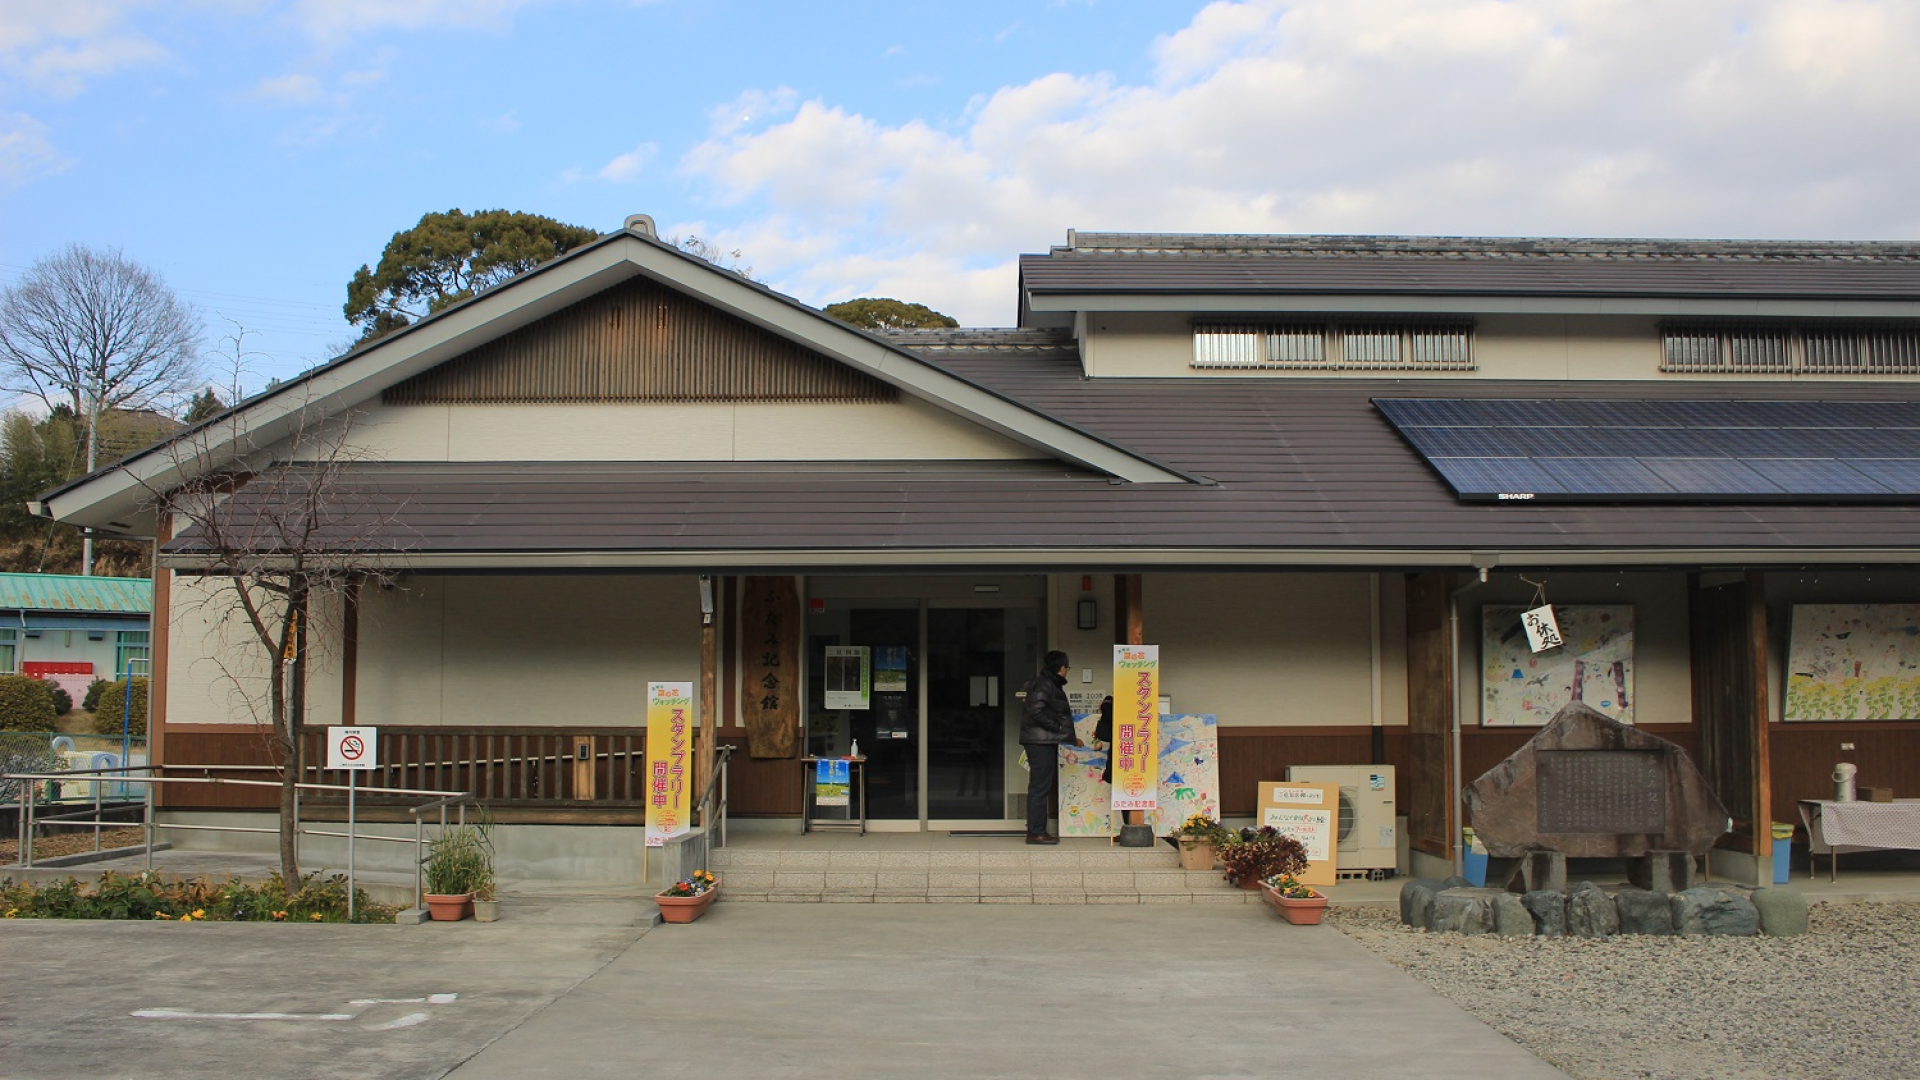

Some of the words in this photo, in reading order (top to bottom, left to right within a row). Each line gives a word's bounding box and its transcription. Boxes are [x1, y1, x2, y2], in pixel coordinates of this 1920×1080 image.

[760, 590, 780, 710] ふたみ記念館
[1526, 612, 1561, 650] お休処
[1136, 671, 1153, 773] スタンプラリー
[670, 708, 686, 810] スタンプラリー
[1119, 723, 1135, 772] 開催中
[652, 761, 668, 810] 開催中
[1113, 800, 1156, 808] ふたみ記念館
